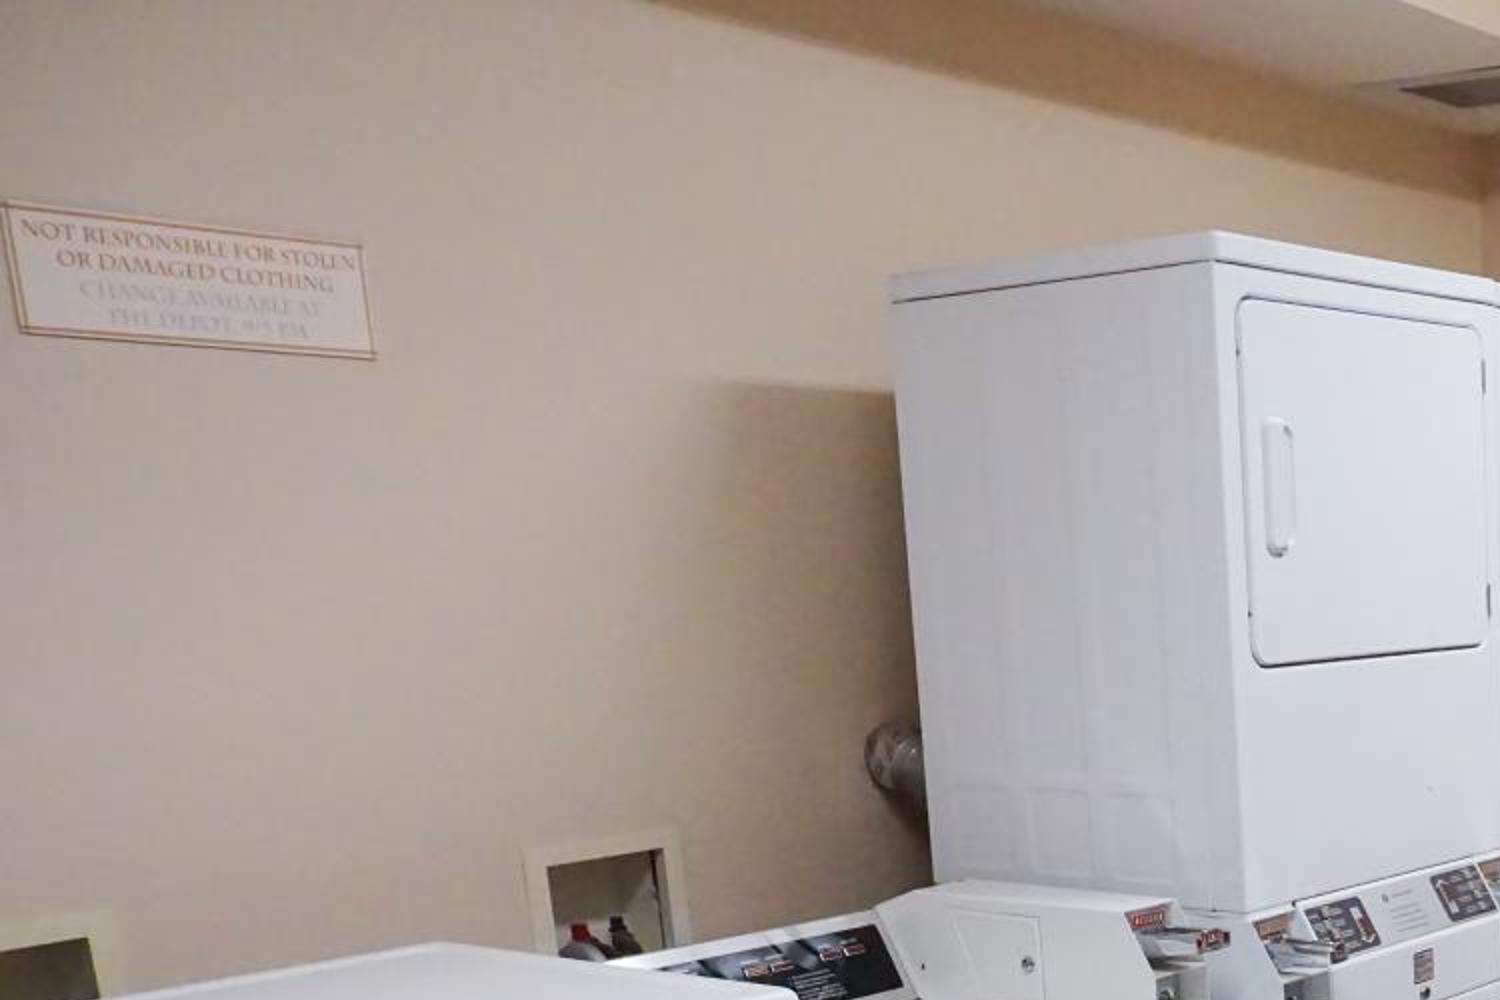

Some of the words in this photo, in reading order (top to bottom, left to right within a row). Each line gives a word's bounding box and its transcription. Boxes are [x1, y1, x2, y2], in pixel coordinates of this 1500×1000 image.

[20, 218, 76, 242] NOT
[82, 225, 226, 257] RESPONSIBLE
[232, 242, 276, 264] FOR
[281, 248, 356, 272] STOLEN
[56, 249, 95, 270] OR
[98, 252, 216, 281] DAMAGED
[220, 266, 335, 294] CLOTHING
[80, 280, 176, 305] CHANGE
[184, 289, 288, 315] AVAILABLE
